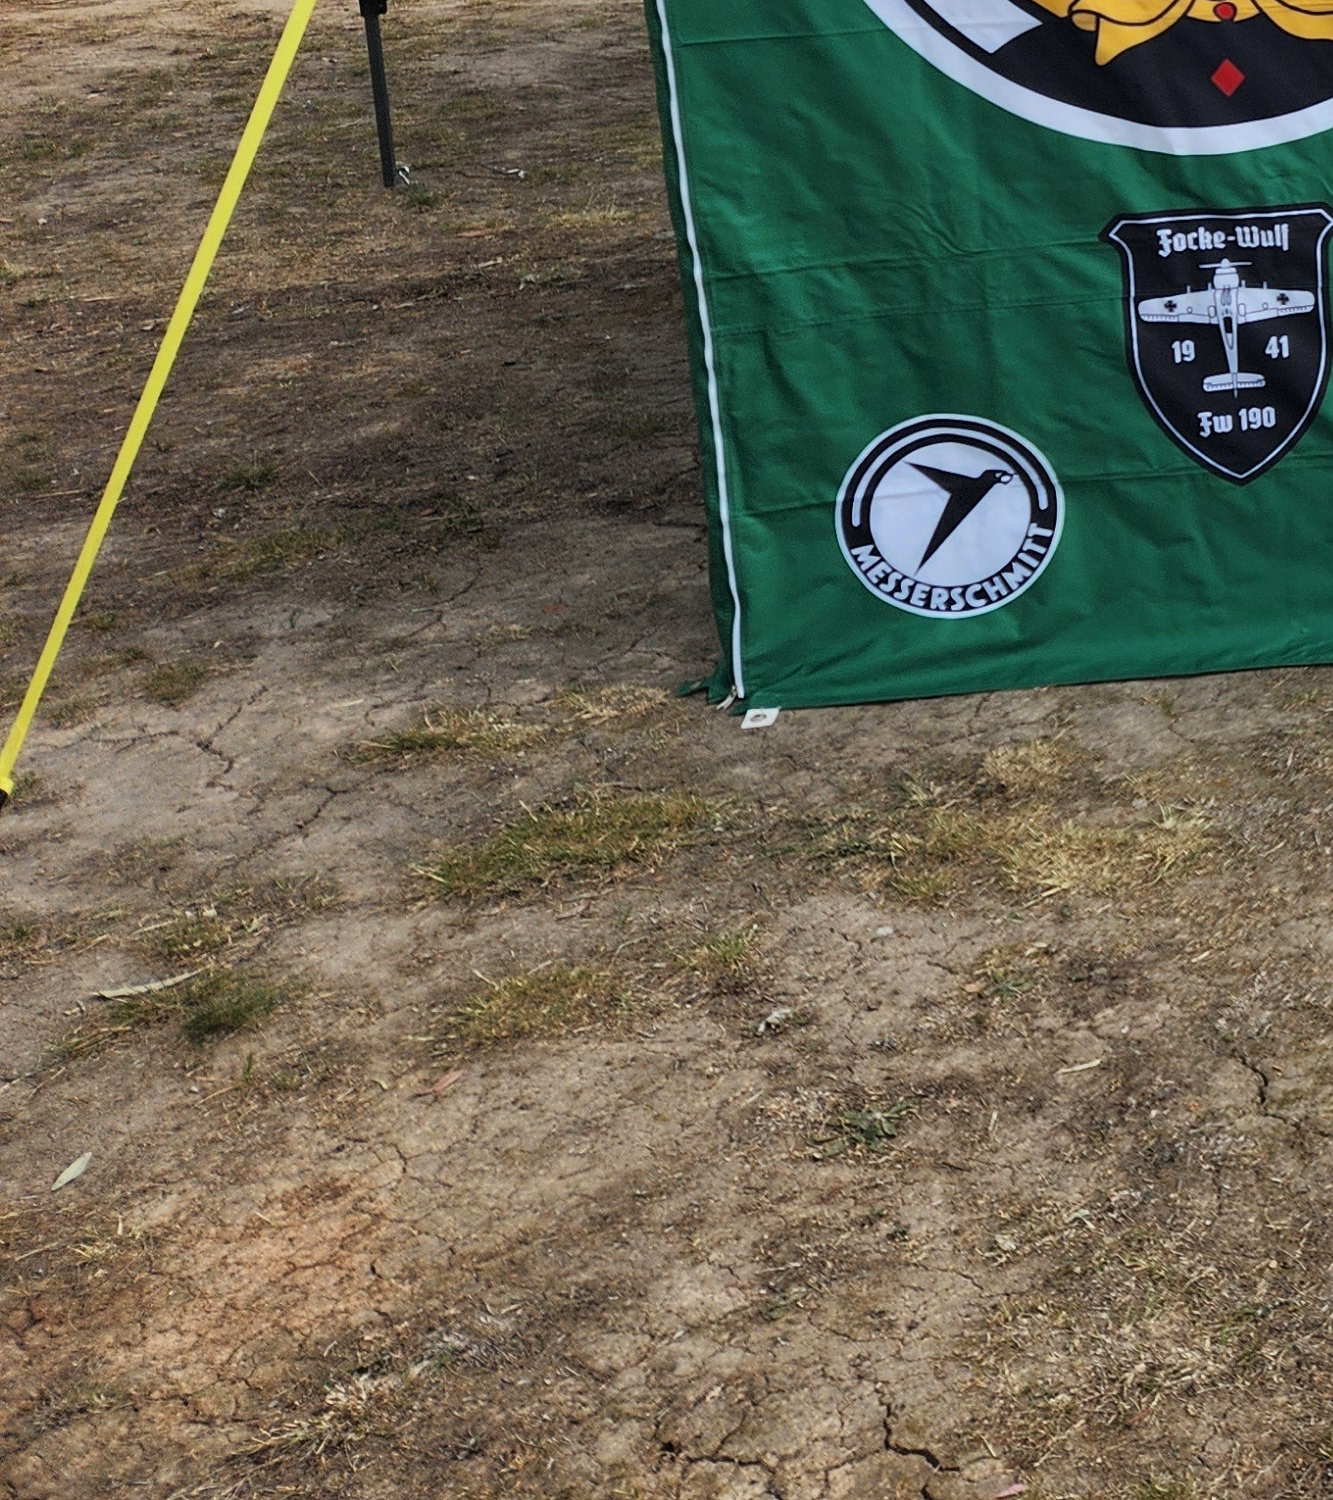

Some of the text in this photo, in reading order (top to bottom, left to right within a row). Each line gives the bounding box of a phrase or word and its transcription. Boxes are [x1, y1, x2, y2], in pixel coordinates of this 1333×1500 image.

[1156, 224, 1289, 258] Focke-Wulf
[1172, 335, 1290, 364] 19 41
[1238, 406, 1276, 431] 190
[850, 522, 1054, 611] MESSERSCHMITT
